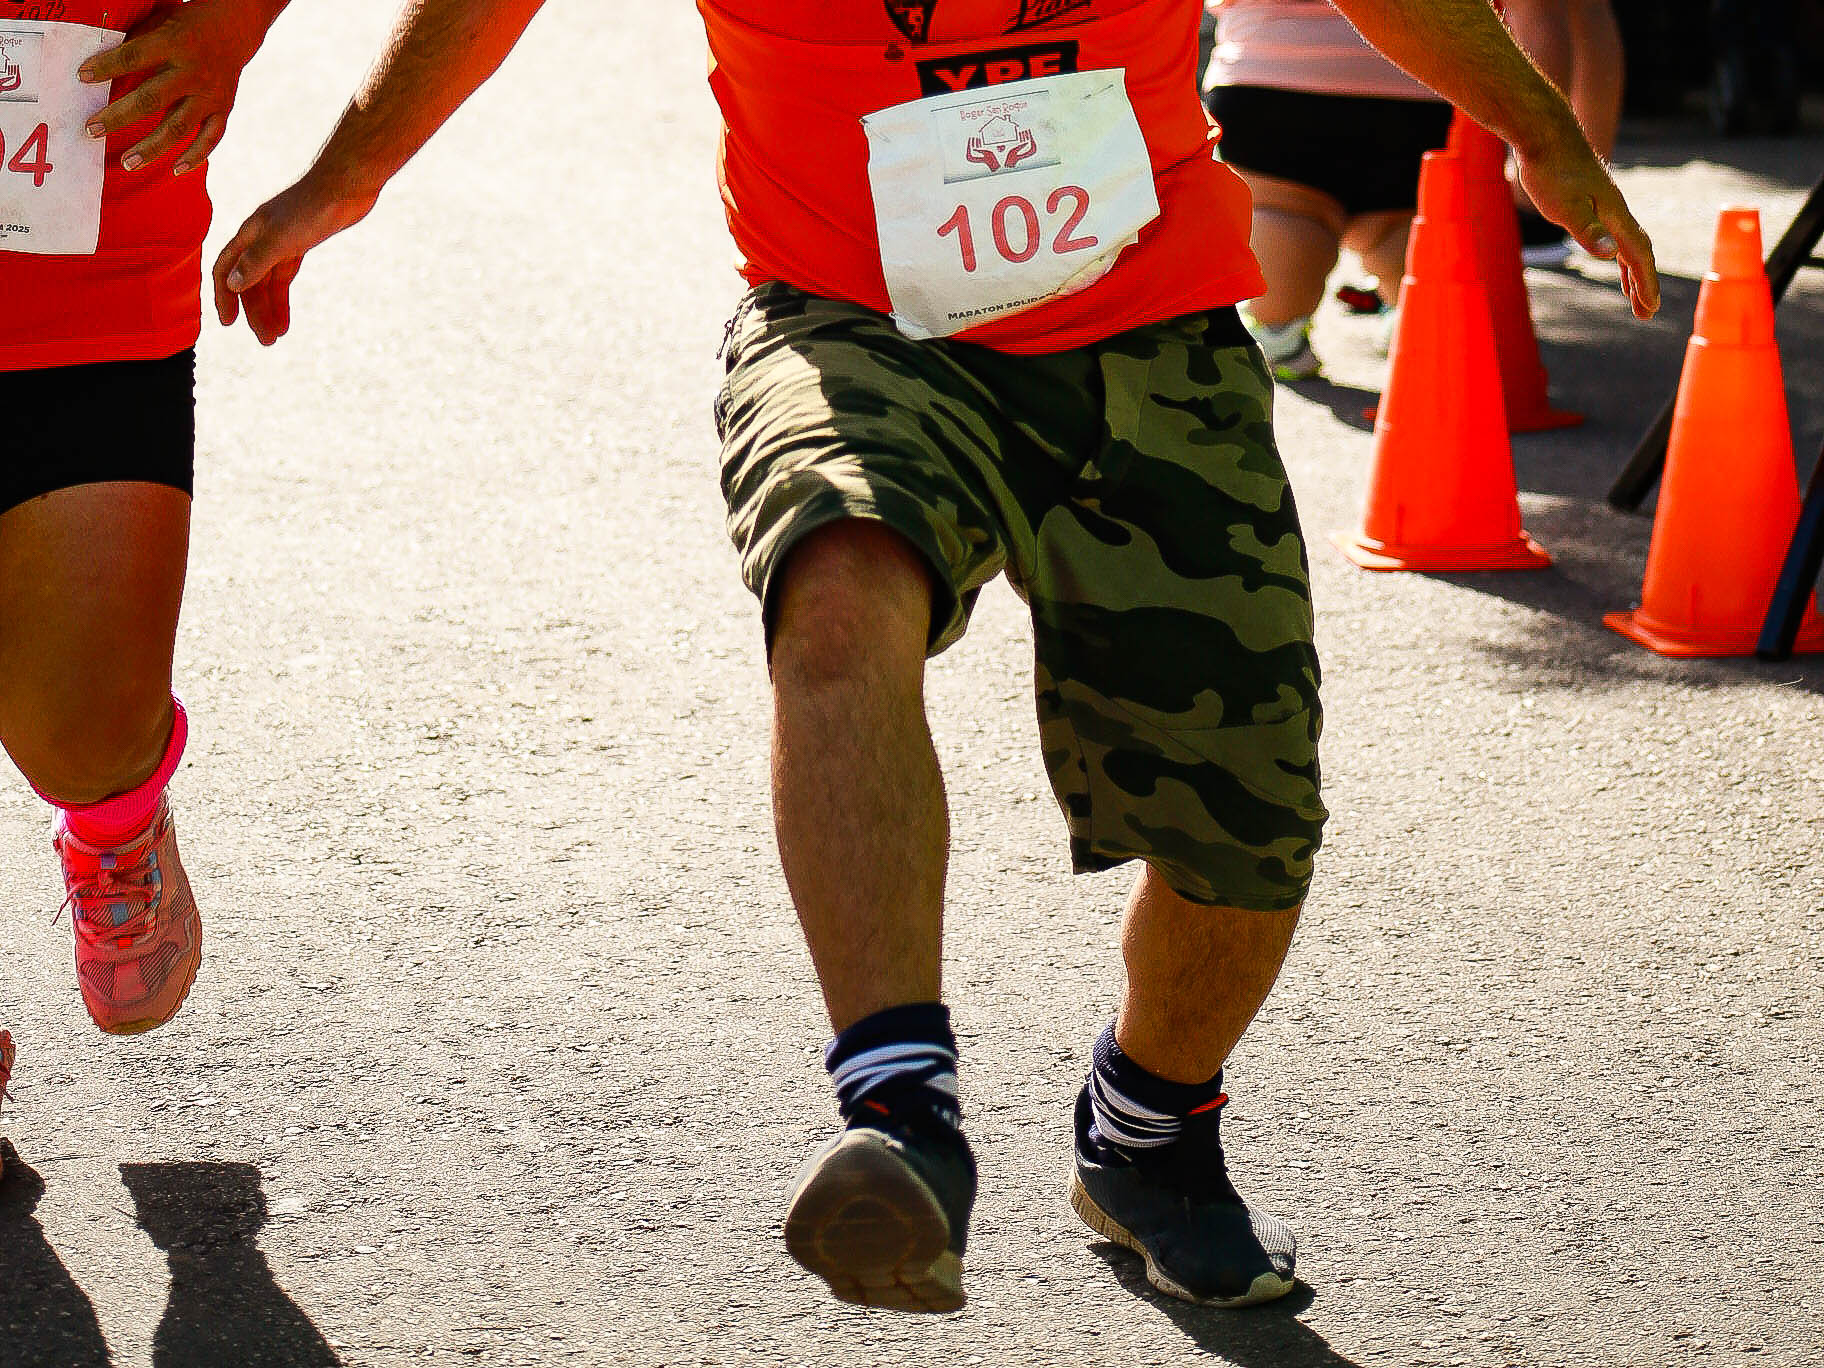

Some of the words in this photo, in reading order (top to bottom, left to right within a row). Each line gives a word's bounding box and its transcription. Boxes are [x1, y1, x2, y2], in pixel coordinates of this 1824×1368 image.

[0, 123, 53, 187] 4
[6, 224, 30, 233] 2025
[937, 185, 1098, 272] 102
[947, 304, 1004, 320] MARATON
